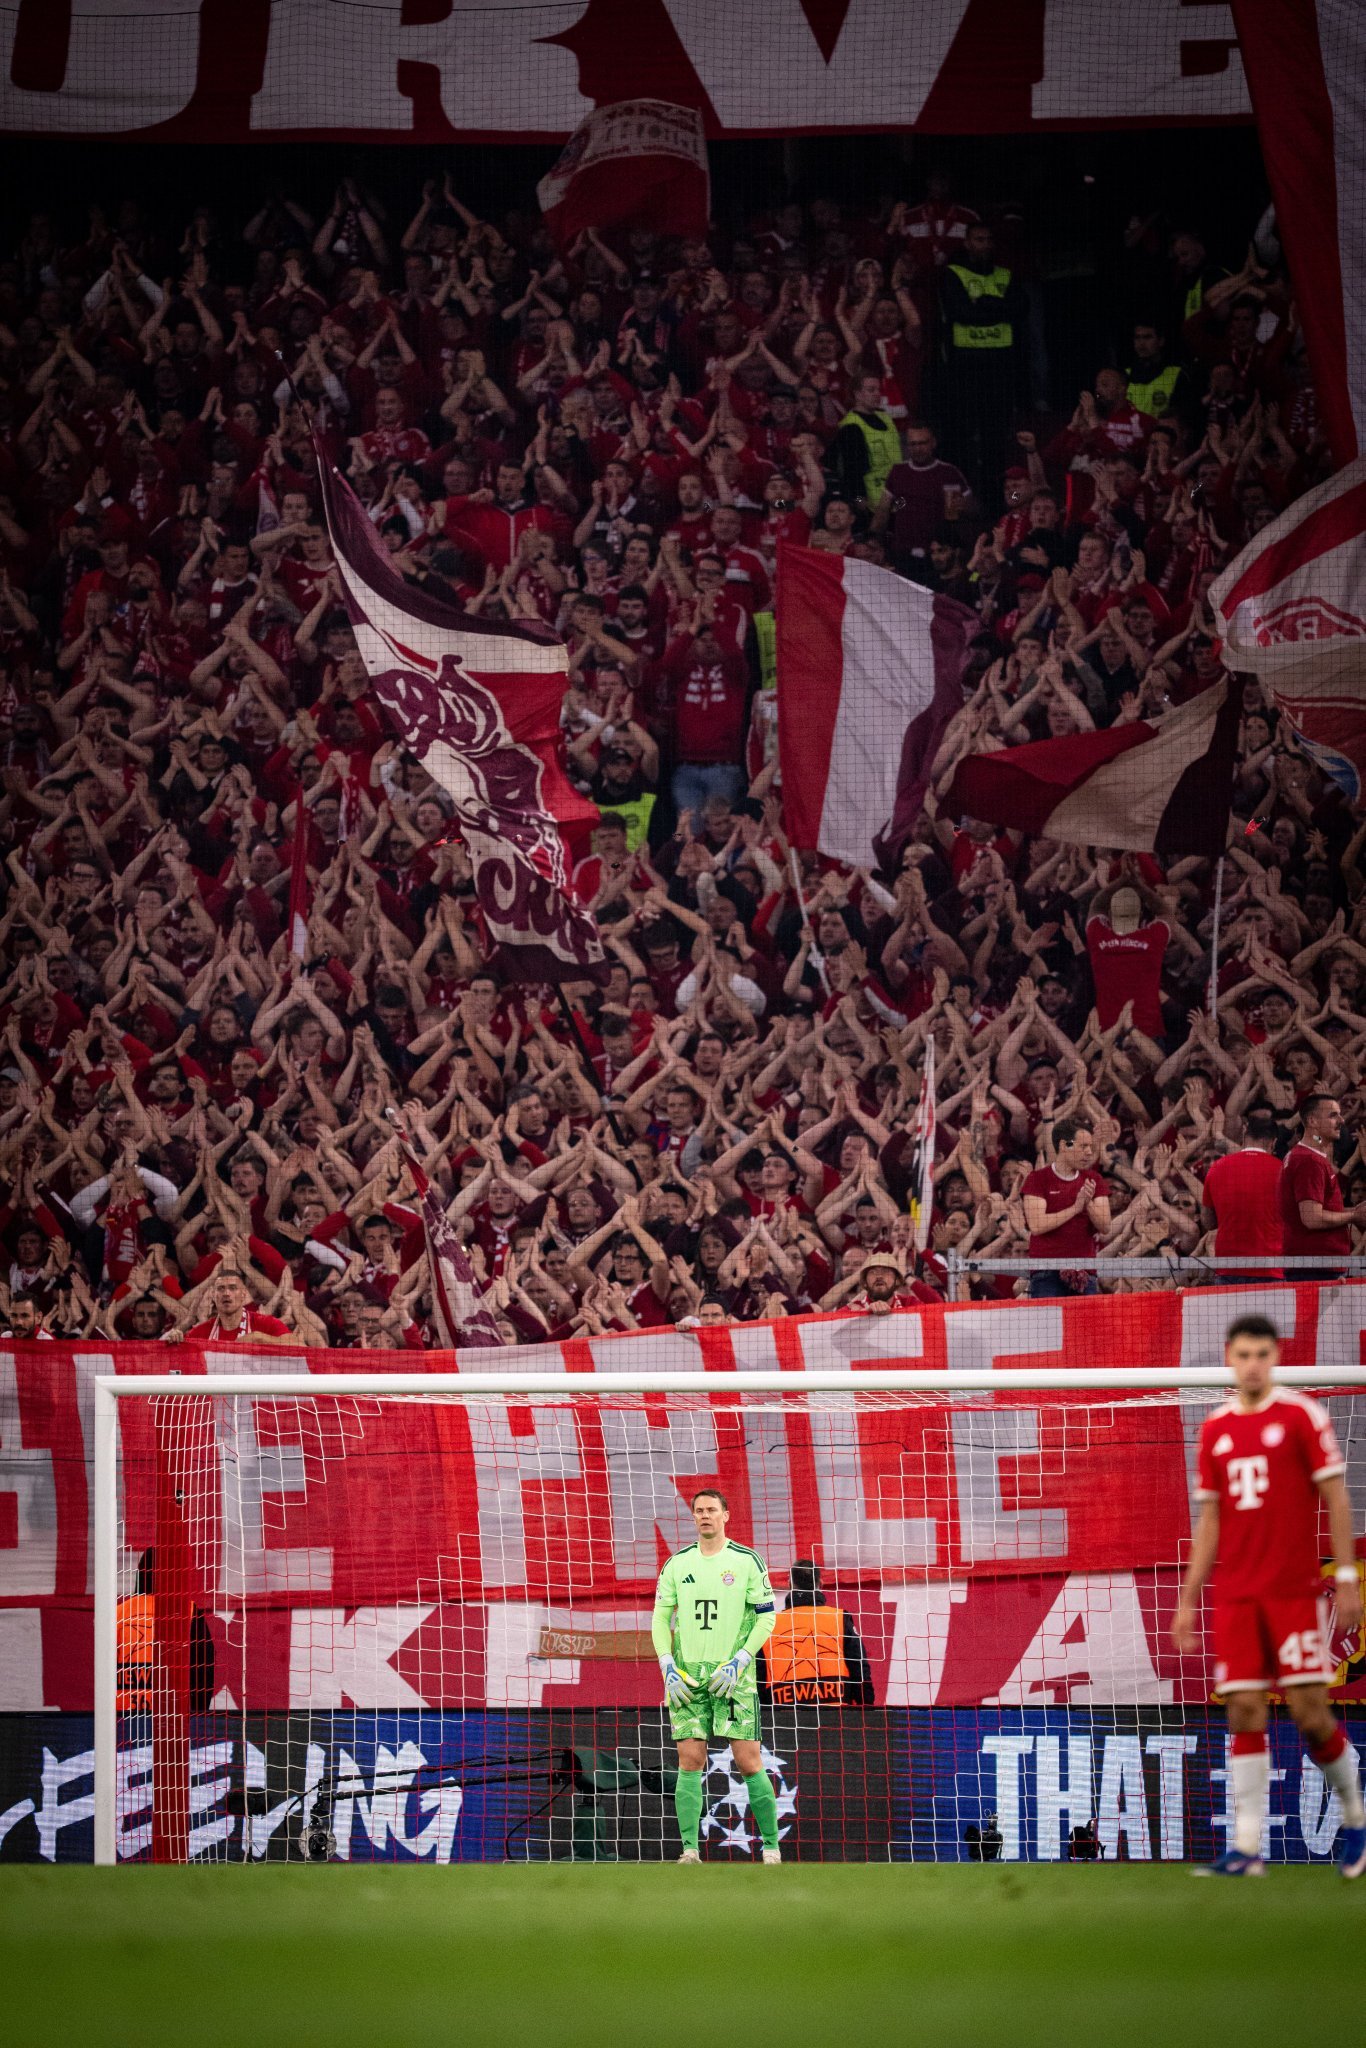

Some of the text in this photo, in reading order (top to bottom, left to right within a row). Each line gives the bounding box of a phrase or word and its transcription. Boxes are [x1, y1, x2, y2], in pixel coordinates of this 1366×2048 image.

[1227, 1455, 1269, 1511] T
[695, 1599, 718, 1630] T
[541, 1631, 597, 1655] USP
[1278, 1629, 1322, 1671] 45
[773, 1681, 845, 1705] TEWARD
[982, 1735, 1198, 1860] THAT
